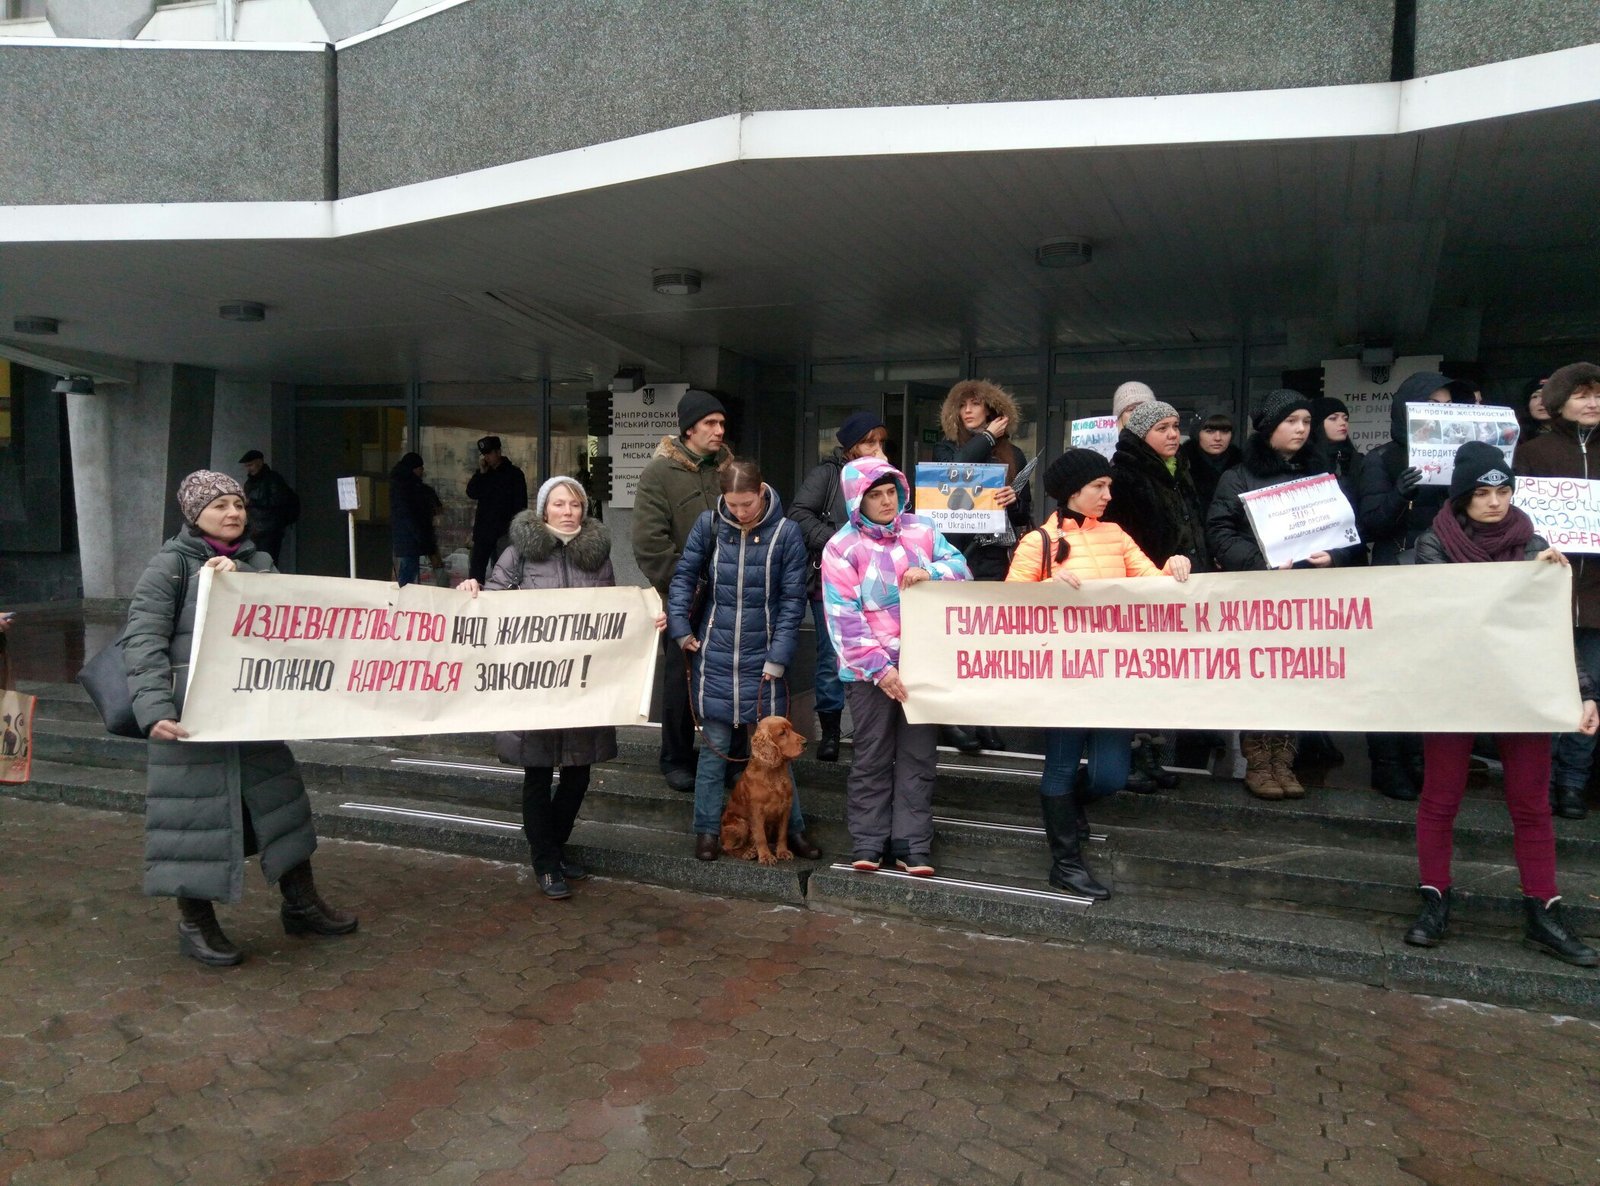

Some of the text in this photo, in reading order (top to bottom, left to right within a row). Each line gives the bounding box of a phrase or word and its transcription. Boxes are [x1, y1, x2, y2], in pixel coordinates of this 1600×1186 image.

[1345, 391, 1393, 402] THE MAY
[615, 411, 678, 419] ДНІПРОВСЬКИ
[615, 420, 678, 429] МІСЬКИЙ ГОЛОВ
[1353, 431, 1390, 440] DNIPR
[1411, 448, 1457, 458] Утвердите
[931, 511, 991, 520] Stop doghunters
[945, 597, 1374, 635] ГУМАННОЕ ОТНОШЕНИЕ К ЖИВОТНЫМ
[231, 603, 628, 648] ИЗДЕВАТЕЛЬСТВО НАД ЖИВОТНЫМИ
[956, 642, 1346, 680] ВАЖНЫЙ ШАГ РАЗВИТИЯ СТРАНЫ
[232, 657, 335, 694] ДОЛЖНО
[346, 659, 464, 693] КАРАТЬСЯ
[474, 658, 575, 692] ЗАКОНОМ
